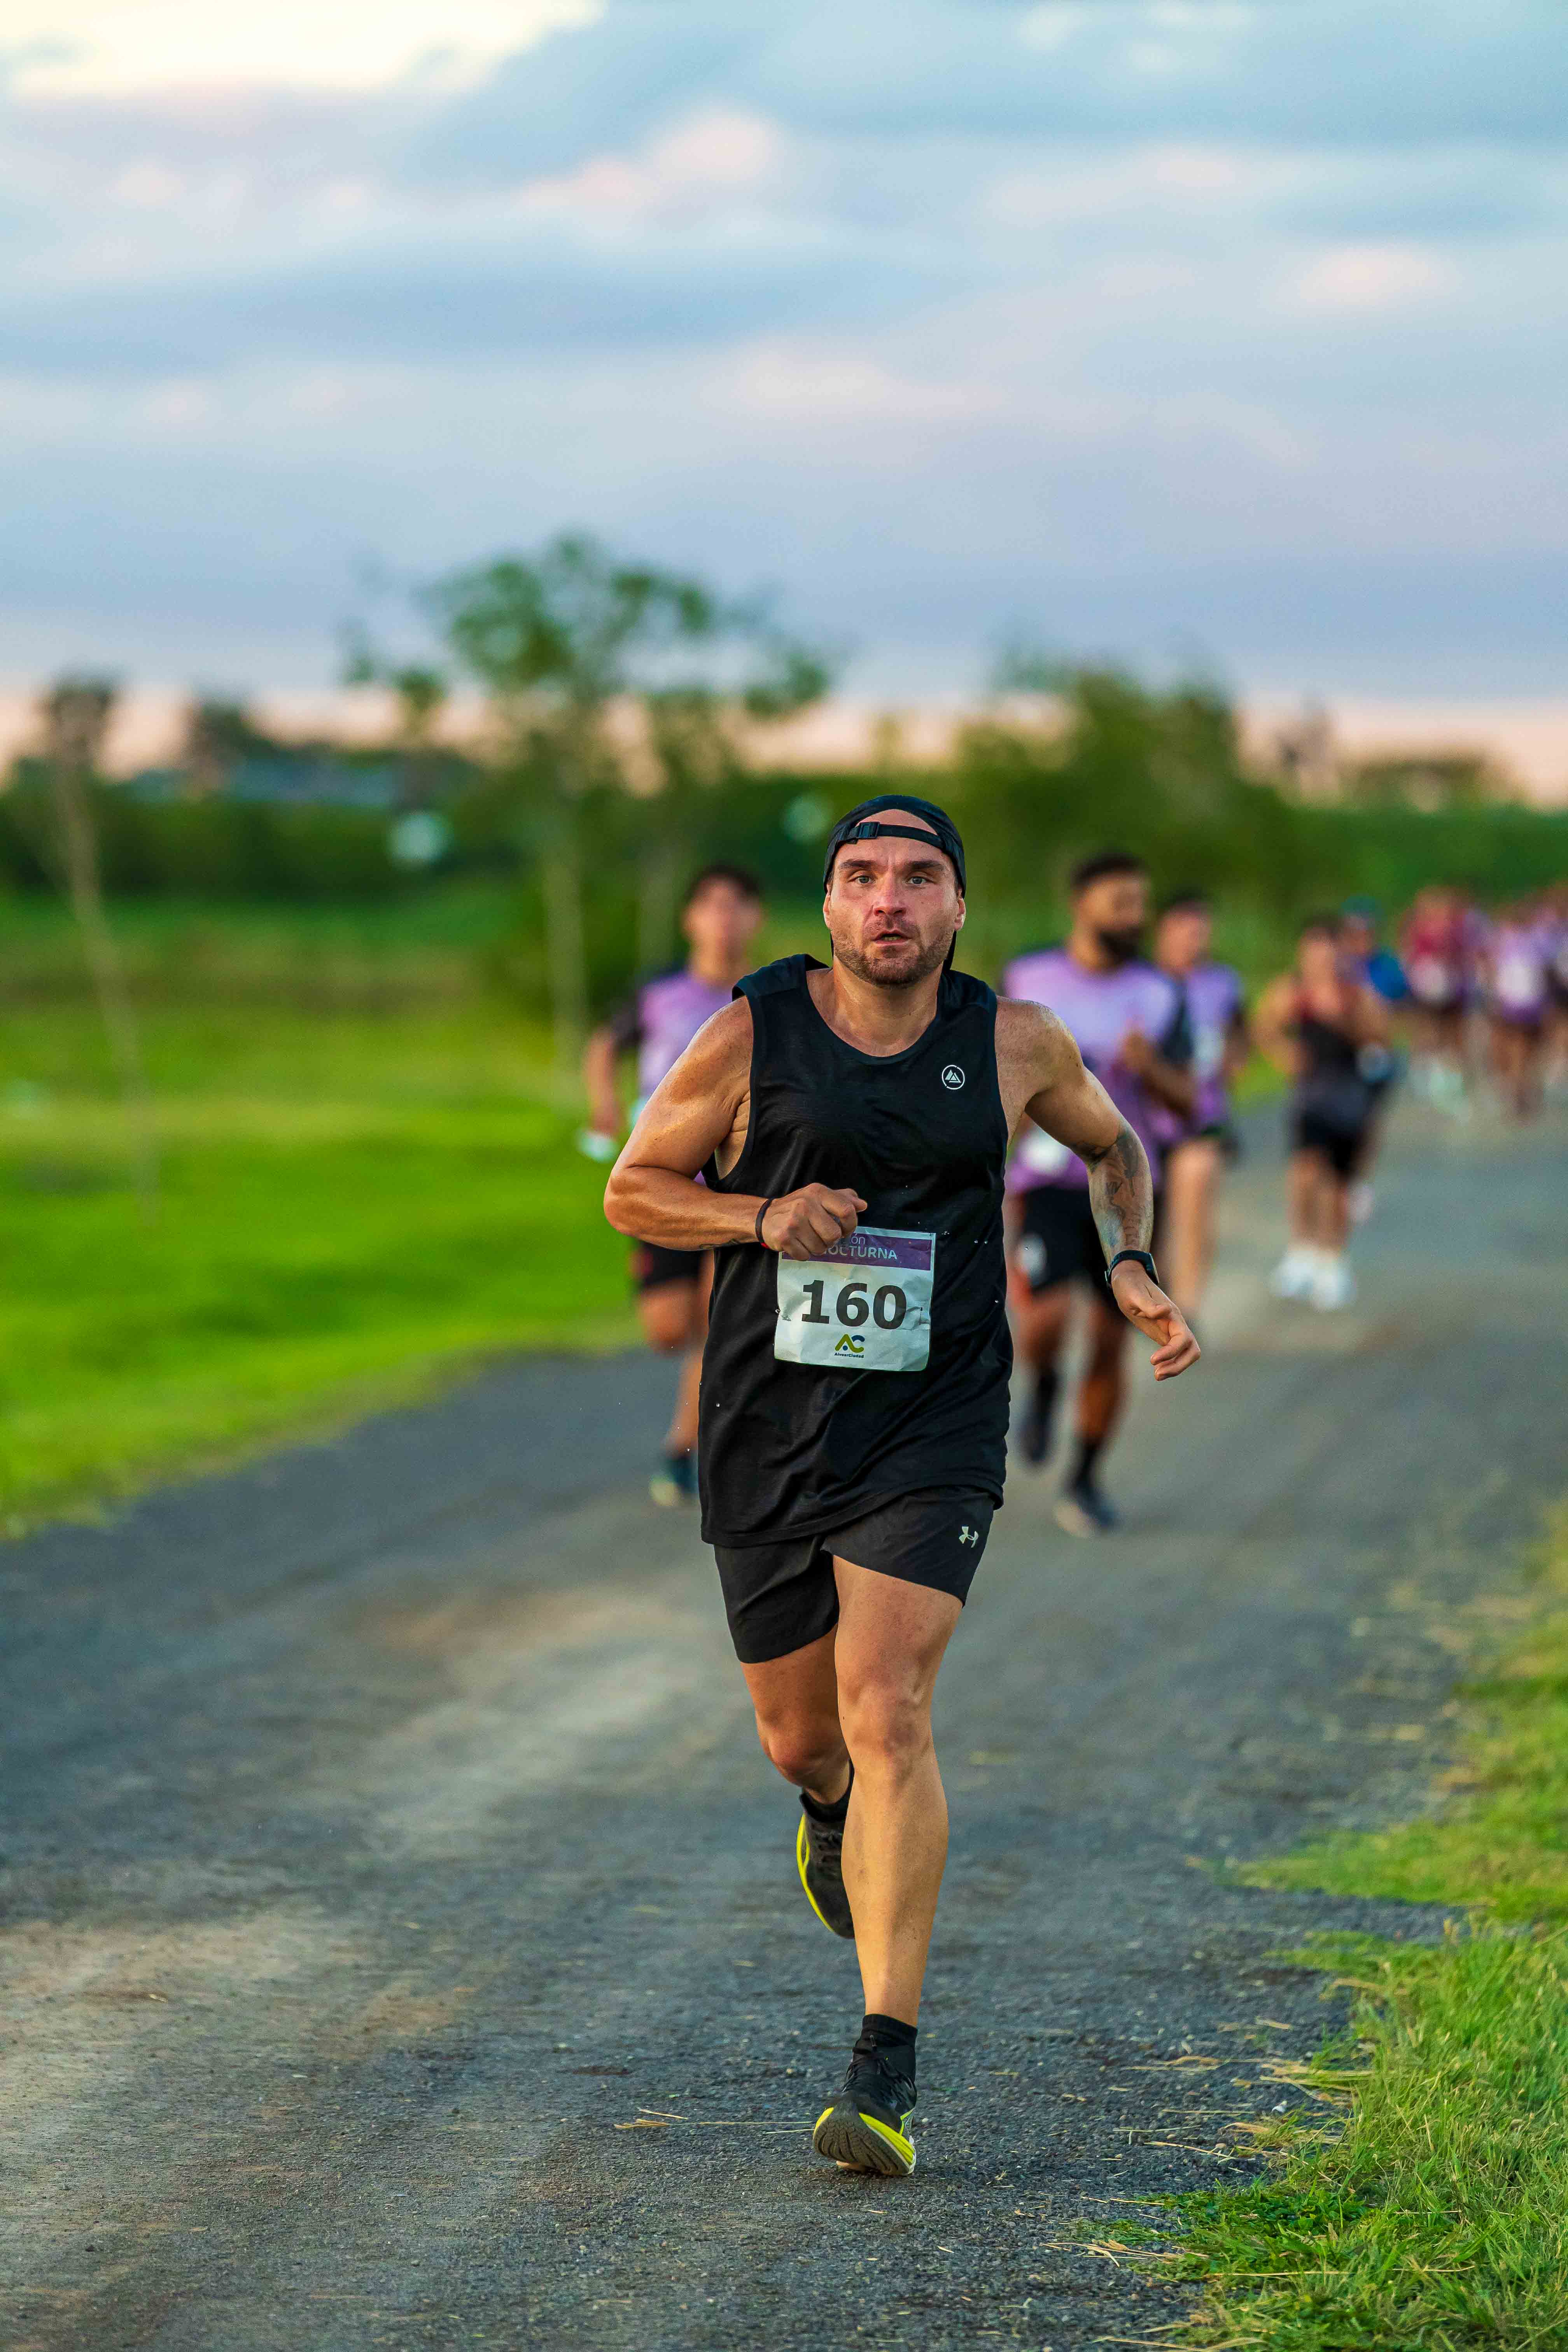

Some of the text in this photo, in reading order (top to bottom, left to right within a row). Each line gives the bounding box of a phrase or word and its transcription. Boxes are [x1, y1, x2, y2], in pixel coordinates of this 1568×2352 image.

[851, 1233, 865, 1245] ón
[823, 1244, 897, 1260] OCTURNA
[802, 1280, 907, 1330] 160
